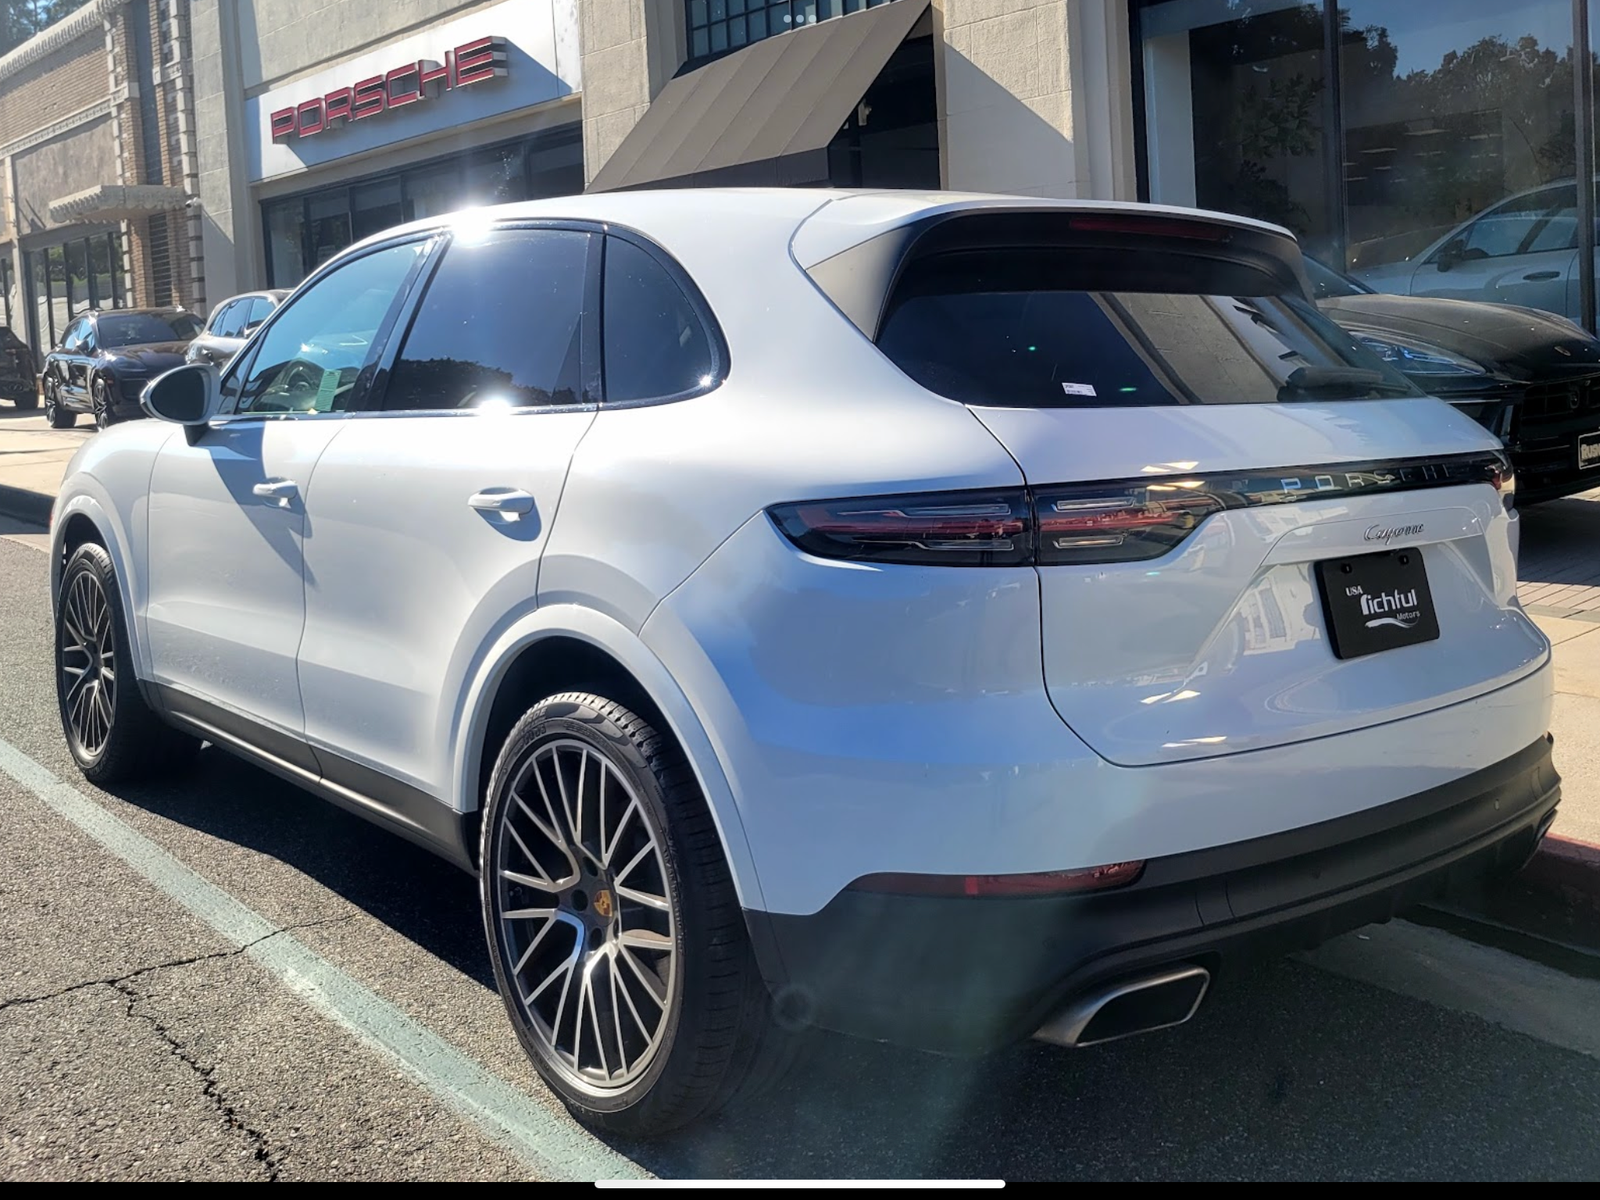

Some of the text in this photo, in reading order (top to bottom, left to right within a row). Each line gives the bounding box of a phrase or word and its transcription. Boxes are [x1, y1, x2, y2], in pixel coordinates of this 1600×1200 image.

[270, 35, 502, 145] PORSCHE
[1364, 523, 1424, 545] Cayenne
[1345, 585, 1363, 596] USA
[1396, 610, 1420, 621] Motors
